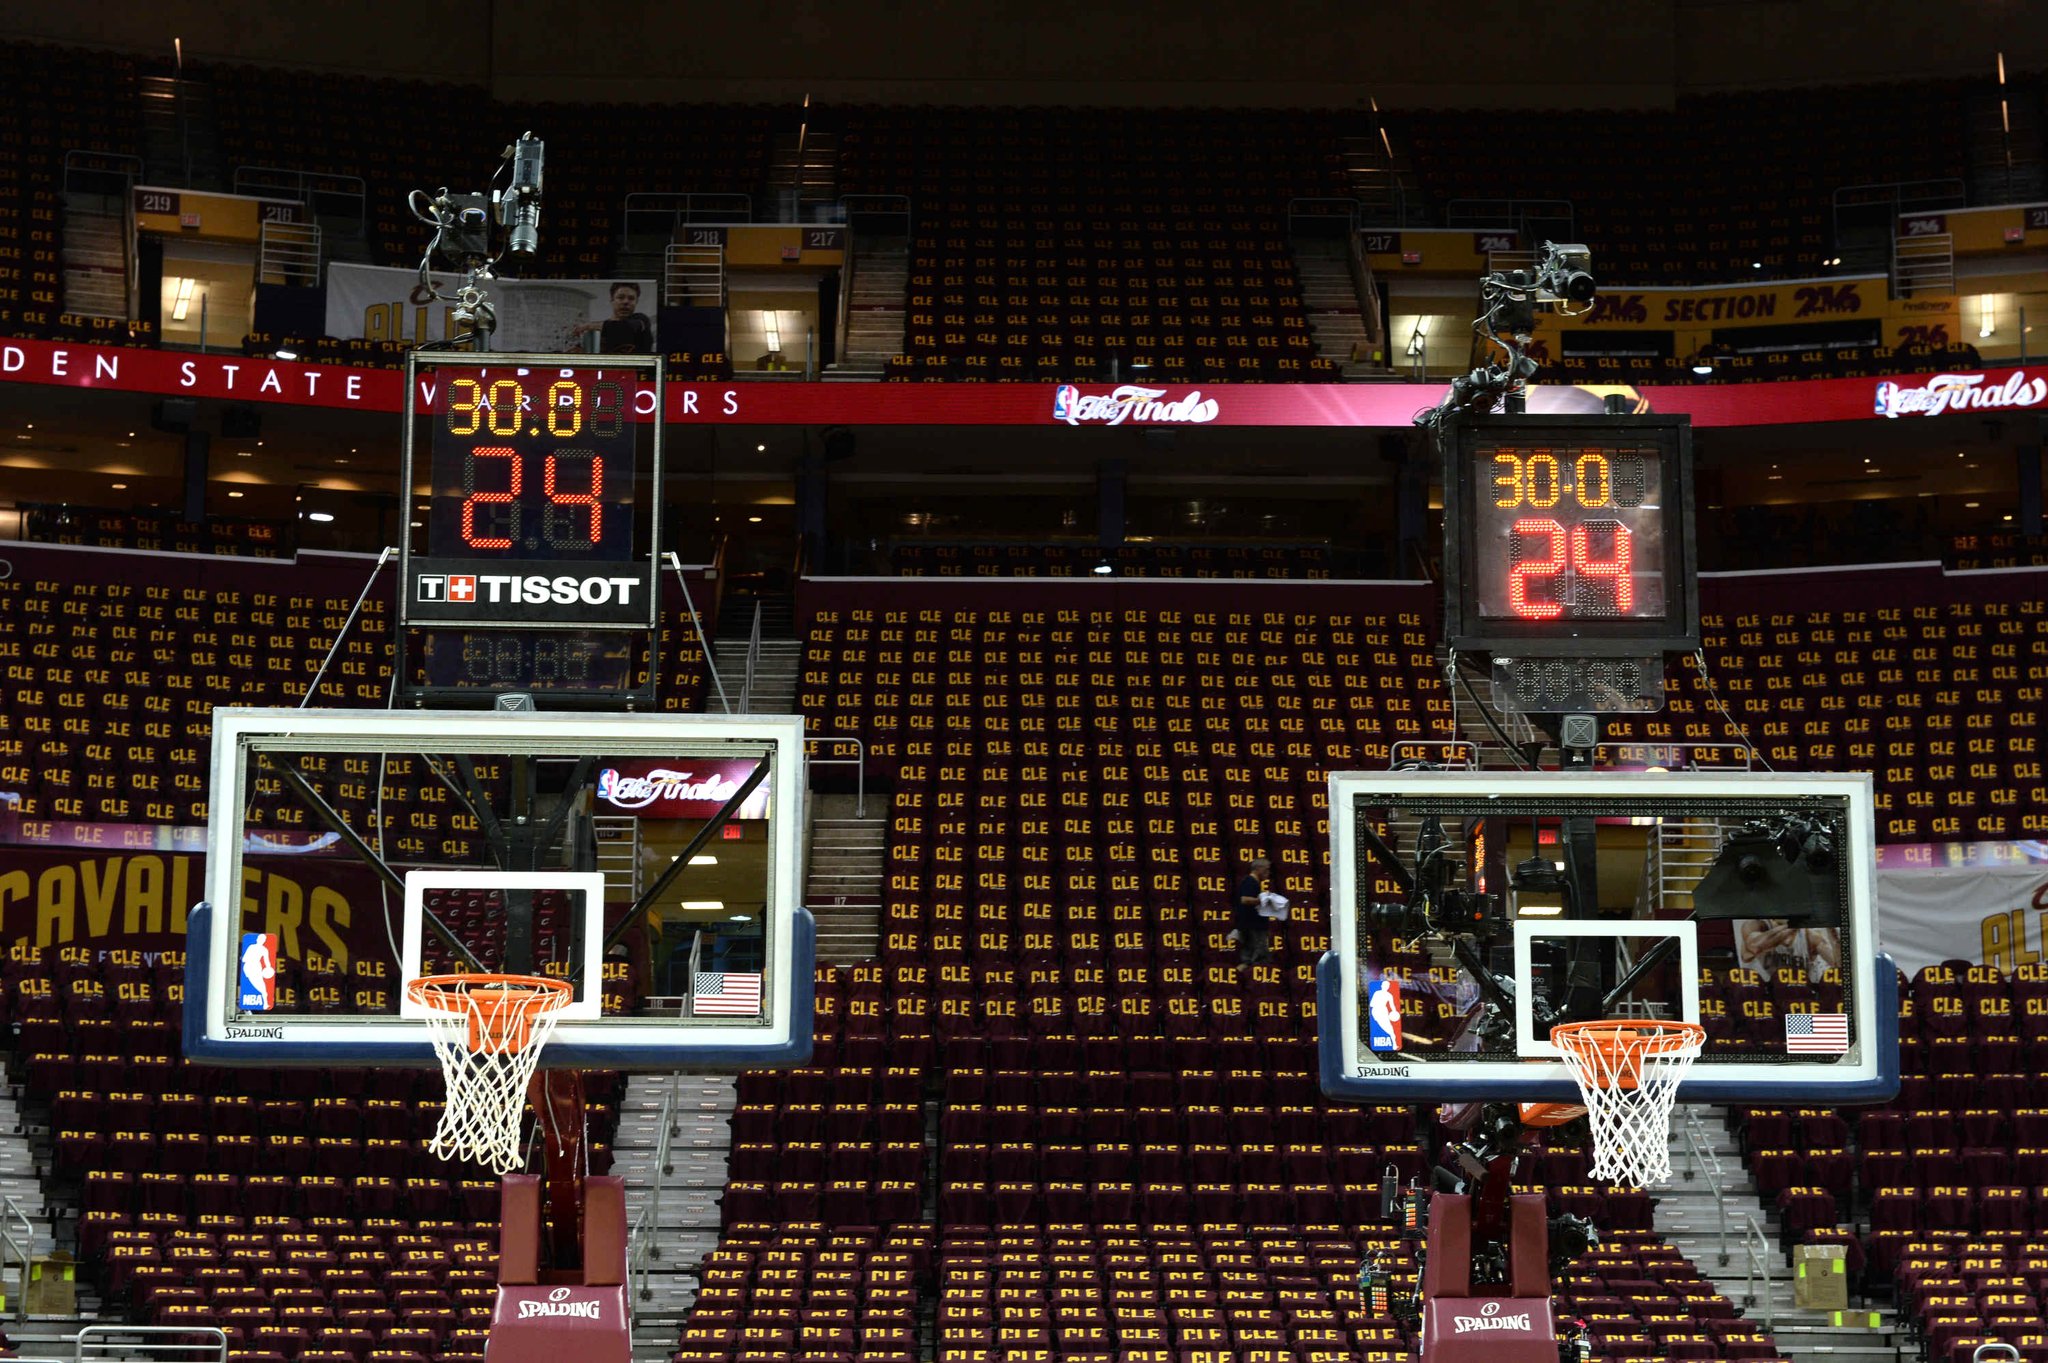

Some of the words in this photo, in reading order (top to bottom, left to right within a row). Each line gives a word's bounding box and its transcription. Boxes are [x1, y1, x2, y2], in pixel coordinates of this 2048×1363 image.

[143, 194, 171, 212] 219
[266, 206, 292, 223] 218
[693, 230, 719, 245] 218
[810, 231, 836, 246] 217
[1367, 235, 1393, 250] 217
[31, 290, 54, 303] CLE
[1664, 293, 1776, 322] SECTION
[59, 313, 83, 327] CLE
[912, 314, 933, 326] CLE
[914, 335, 935, 347] CLE
[1007, 335, 1028, 345] CLE
[1287, 335, 1309, 346] CLE
[891, 353, 913, 366] CLE
[926, 355, 948, 366] CLE
[1074, 356, 1096, 366] CLE
[1164, 357, 1185, 368] CLE
[1278, 358, 1300, 369] CLE
[3, 347, 118, 379] DEN
[180, 361, 361, 400] STATE
[1924, 371, 2048, 416] Finals
[1106, 385, 1220, 426] Finals
[461, 447, 603, 549] 24
[1510, 519, 1632, 618] 24
[183, 588, 206, 600] CLE
[479, 575, 640, 605] TISSOT
[63, 601, 87, 615] CLE
[175, 607, 198, 620] CLE
[251, 611, 273, 625] CLE
[1057, 610, 1079, 623] CLE
[1159, 611, 1180, 624] CLE
[1701, 615, 1723, 626] CLE
[880, 630, 902, 641] CLE
[1922, 626, 1945, 638] CLE
[269, 635, 293, 649] CLE
[1125, 650, 1148, 664] CLE
[1302, 652, 1325, 665] CLE
[1720, 656, 1743, 668] CLE
[1835, 651, 1858, 664] CLE
[47, 668, 72, 684] CLE
[342, 661, 366, 676] CLE
[1878, 669, 1903, 682] CLE
[1992, 666, 2017, 679] CLE
[124, 671, 150, 686] CLE
[167, 674, 192, 689] CLE
[206, 675, 230, 690] CLE
[839, 672, 862, 685] CLE
[1271, 674, 1296, 687] CLE
[17, 689, 44, 705] CLE
[103, 693, 129, 707] CLE
[145, 696, 170, 712] CLE
[801, 694, 826, 707] CLE
[909, 693, 933, 706] CLE
[1166, 695, 1190, 709] CLE
[1896, 693, 1921, 707] CLE
[1745, 698, 1769, 712] CLE
[24, 717, 51, 732] CLE
[909, 715, 934, 728] CLE
[1020, 717, 1044, 731] CLE
[1763, 721, 1789, 736] CLE
[1926, 714, 1952, 728] CLE
[145, 723, 171, 738] CLE
[1685, 723, 1711, 737] CLE
[85, 744, 112, 761] CLE
[906, 742, 932, 756] CLE
[1136, 743, 1161, 758] CLE
[1287, 742, 1312, 757] CLE
[1771, 745, 1797, 760] CLE
[1968, 738, 1994, 753] CLE
[127, 746, 155, 761] CLE
[300, 756, 326, 771] CLE
[2013, 762, 2041, 779] CLE
[1, 766, 31, 783] CLE
[900, 765, 927, 780] CLE
[1021, 766, 1047, 781] CLE
[1225, 768, 1250, 783] CLE
[132, 773, 159, 790] CLE
[339, 783, 366, 800] CLE
[1947, 791, 1975, 806] CLE
[54, 798, 83, 815] CLE
[895, 793, 923, 808] CLE
[1020, 792, 1047, 807] CLE
[1268, 794, 1295, 810] CLE
[146, 803, 174, 820] CLE
[276, 808, 303, 824] CLE
[23, 822, 50, 838] CLE
[894, 817, 922, 833] CLE
[1148, 818, 1175, 834] CLE
[1977, 816, 2005, 833] CLE
[1022, 846, 1049, 862] CLE
[891, 875, 920, 891] CLE
[1285, 876, 1313, 892] CLE
[0, 854, 350, 975] CAVALERS
[1113, 905, 1143, 921] CLE
[888, 933, 918, 951] CLE
[1024, 933, 1054, 950] CLE
[356, 960, 385, 977] CLE
[897, 967, 927, 984] CLE
[1208, 967, 1238, 985] CLE
[1777, 967, 1807, 985] CLE
[1728, 968, 1760, 985] CLE
[19, 978, 52, 996] CLE
[118, 982, 151, 1001] CLE
[243, 994, 263, 1006] NBA
[1121, 998, 1152, 1016] CLE
[1932, 996, 1964, 1015] CLE
[1979, 997, 2010, 1016] CLE
[850, 1000, 880, 1017] CLE
[1743, 1000, 1773, 1019] CLE
[225, 1026, 284, 1040] SPALDING
[1373, 1036, 1393, 1047] NBA
[1357, 1065, 1411, 1078] SPALDING
[518, 1300, 601, 1320] SPALDING
[1454, 1313, 1531, 1333] SPALDING
